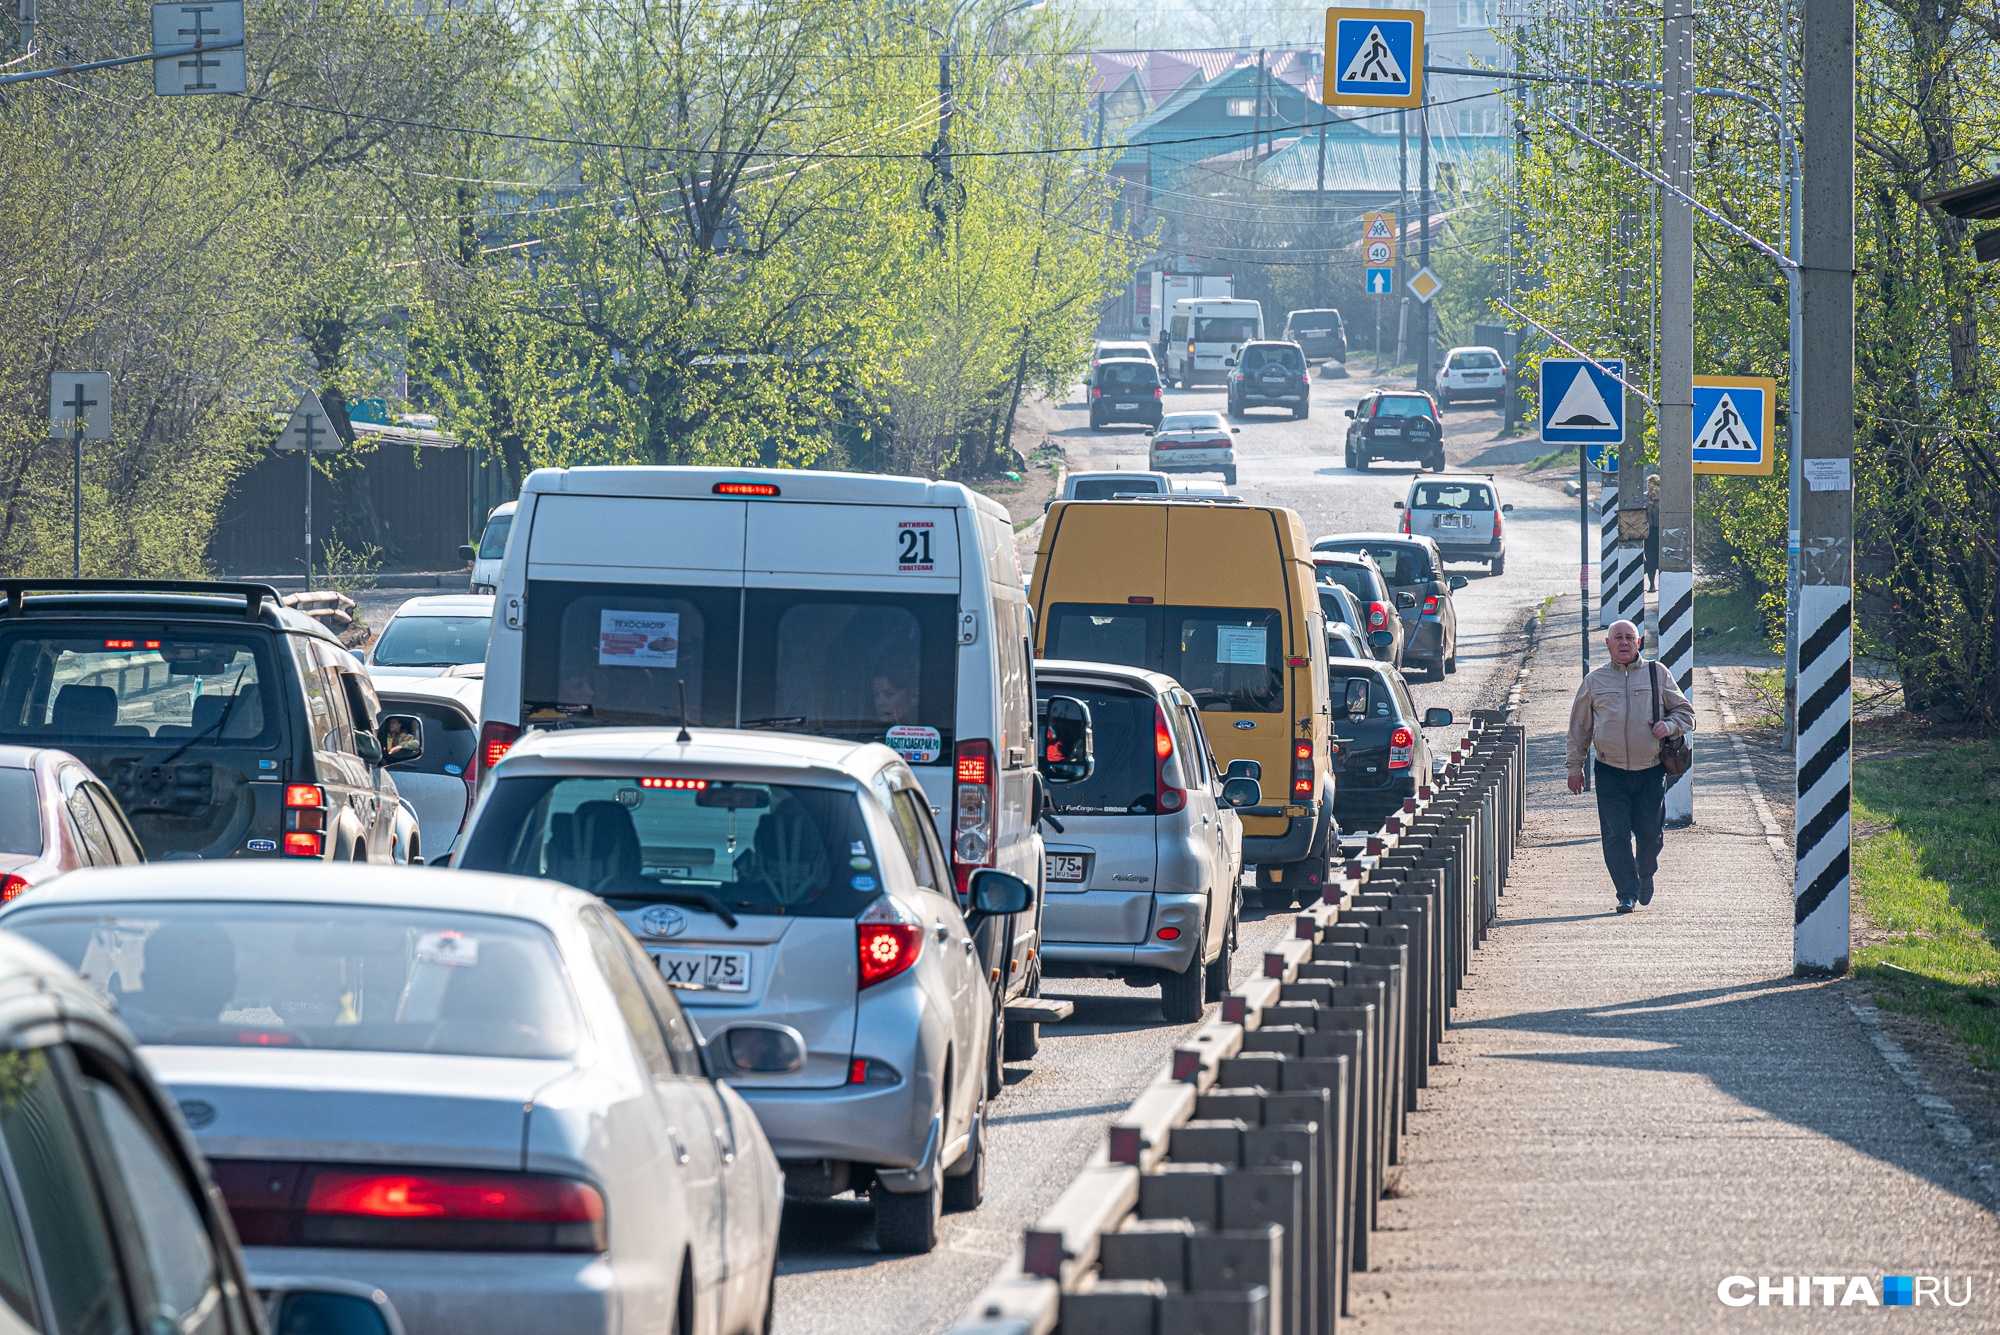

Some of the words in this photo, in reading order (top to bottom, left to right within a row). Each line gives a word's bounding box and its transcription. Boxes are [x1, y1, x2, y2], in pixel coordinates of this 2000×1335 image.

[1372, 248, 1387, 258] 40
[899, 529, 934, 564] 21
[614, 620, 666, 629] ТЕХОСМОТР
[620, 791, 638, 804] FIAT
[1065, 805, 1094, 813] FunCargo
[1058, 857, 1077, 872] 75
[710, 955, 738, 976] 75
